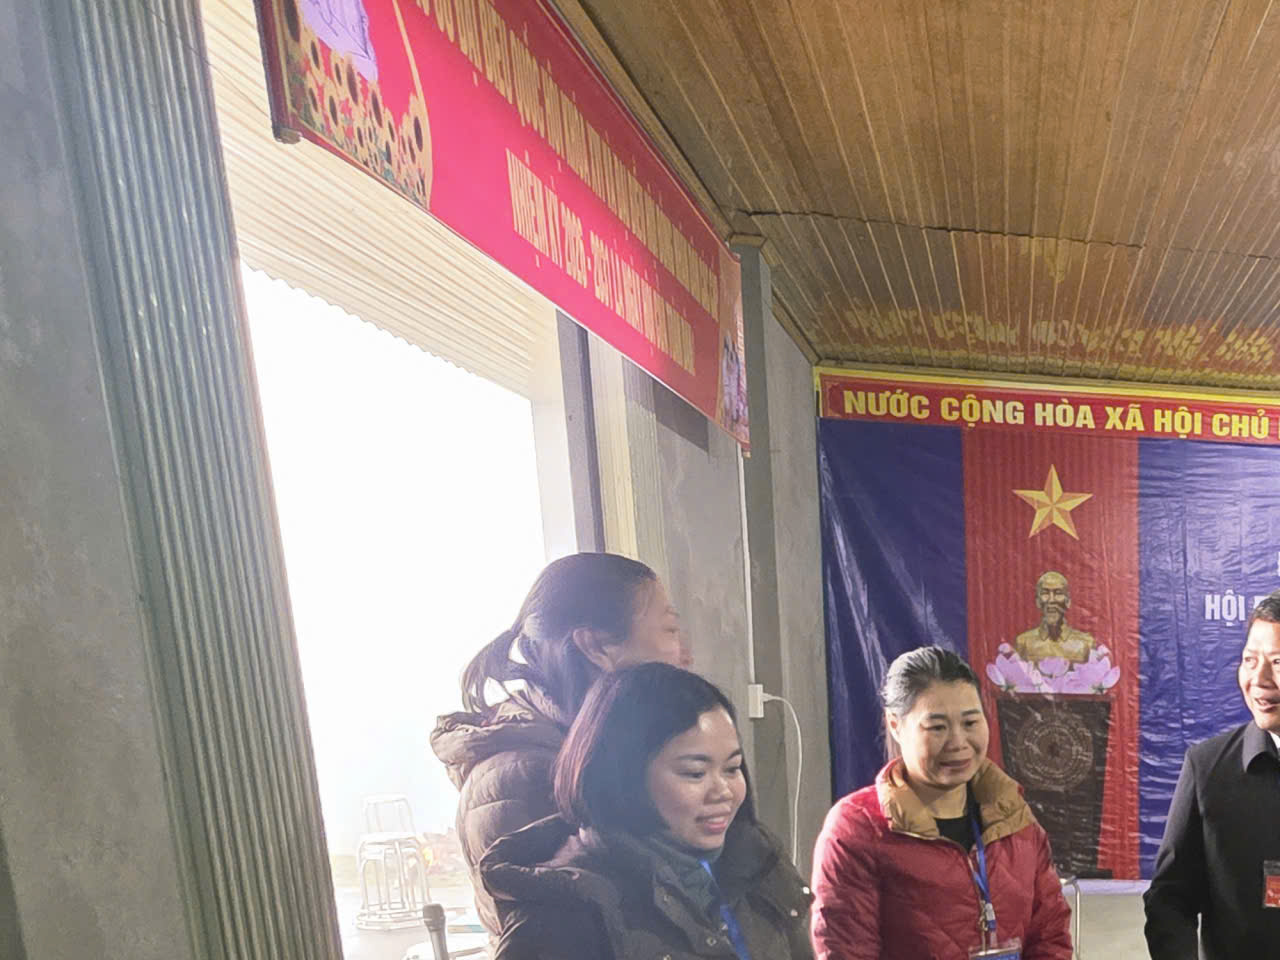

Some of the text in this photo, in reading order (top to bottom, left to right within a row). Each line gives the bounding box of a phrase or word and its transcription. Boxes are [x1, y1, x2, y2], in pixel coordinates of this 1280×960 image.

[843, 389, 930, 418] NƯỚC
[940, 394, 1025, 428] CỘNG
[1034, 399, 1096, 428] HÒA
[1104, 404, 1145, 432] XÃ
[1153, 406, 1203, 439] HỘI
[1211, 408, 1271, 441] CHỦ
[1204, 589, 1246, 627] HỘI
